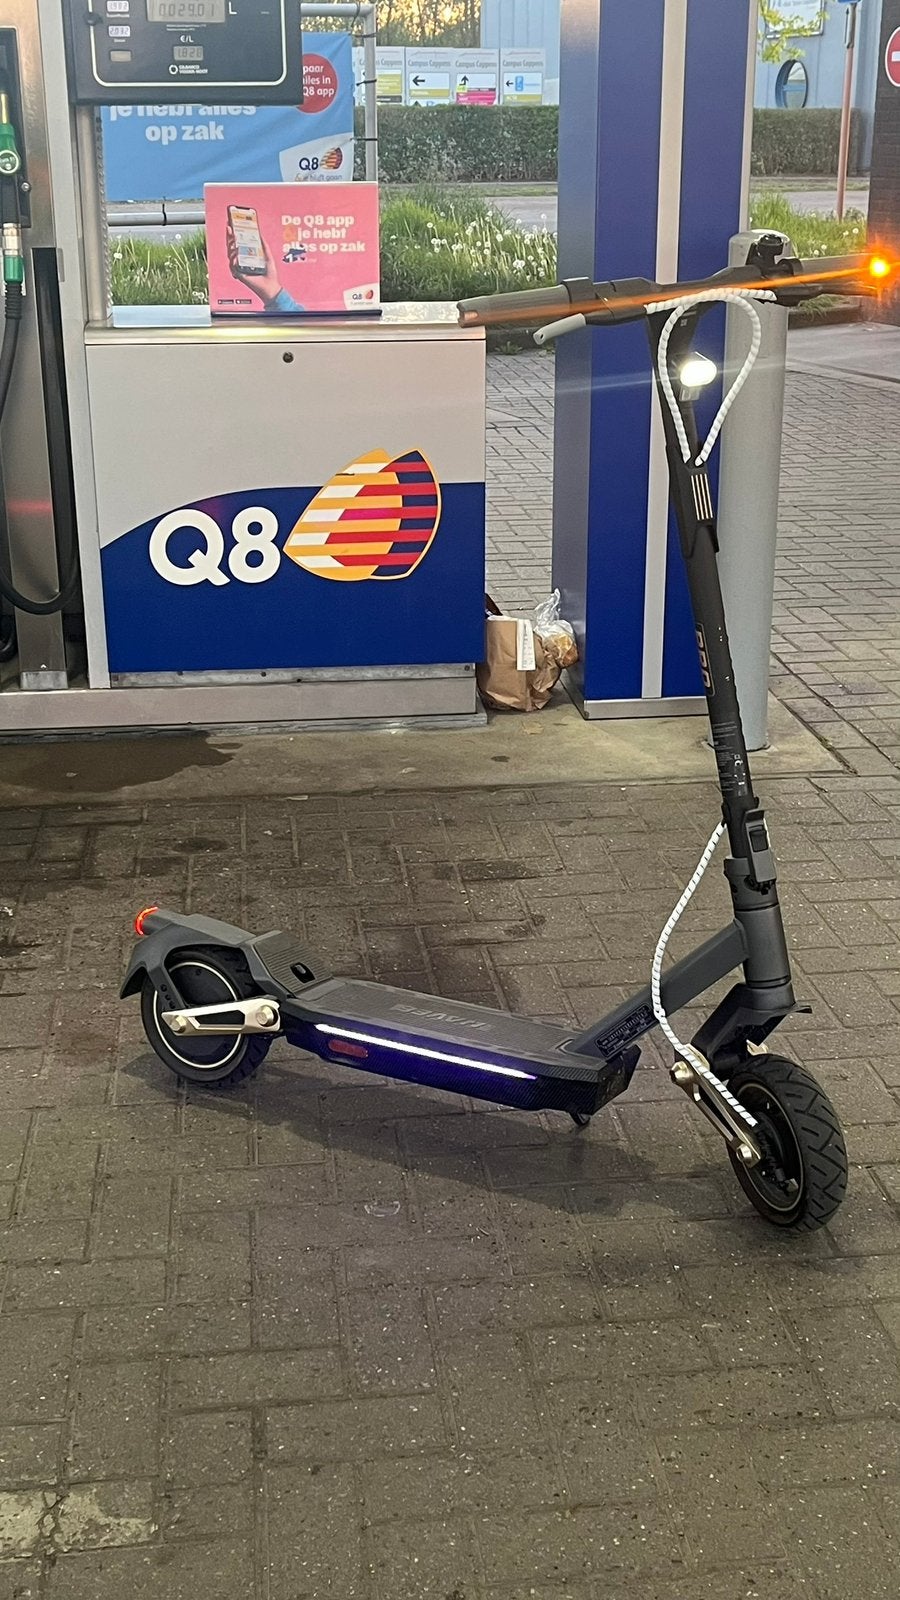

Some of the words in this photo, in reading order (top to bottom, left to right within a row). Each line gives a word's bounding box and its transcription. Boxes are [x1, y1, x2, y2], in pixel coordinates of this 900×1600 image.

[228, 1, 238, 15] L
[322, 75, 331, 85] in
[303, 86, 315, 97] Q8
[317, 88, 335, 98] app
[145, 125, 178, 145] op
[181, 121, 225, 141] zak
[298, 157, 319, 171] Q8
[281, 215, 301, 226] De
[303, 215, 324, 228] Q8
[326, 216, 355, 228] app
[297, 228, 311, 241] je
[313, 228, 347, 239] hebt
[319, 243, 338, 254] op
[340, 241, 366, 252] zak
[148, 506, 282, 587] Q8
